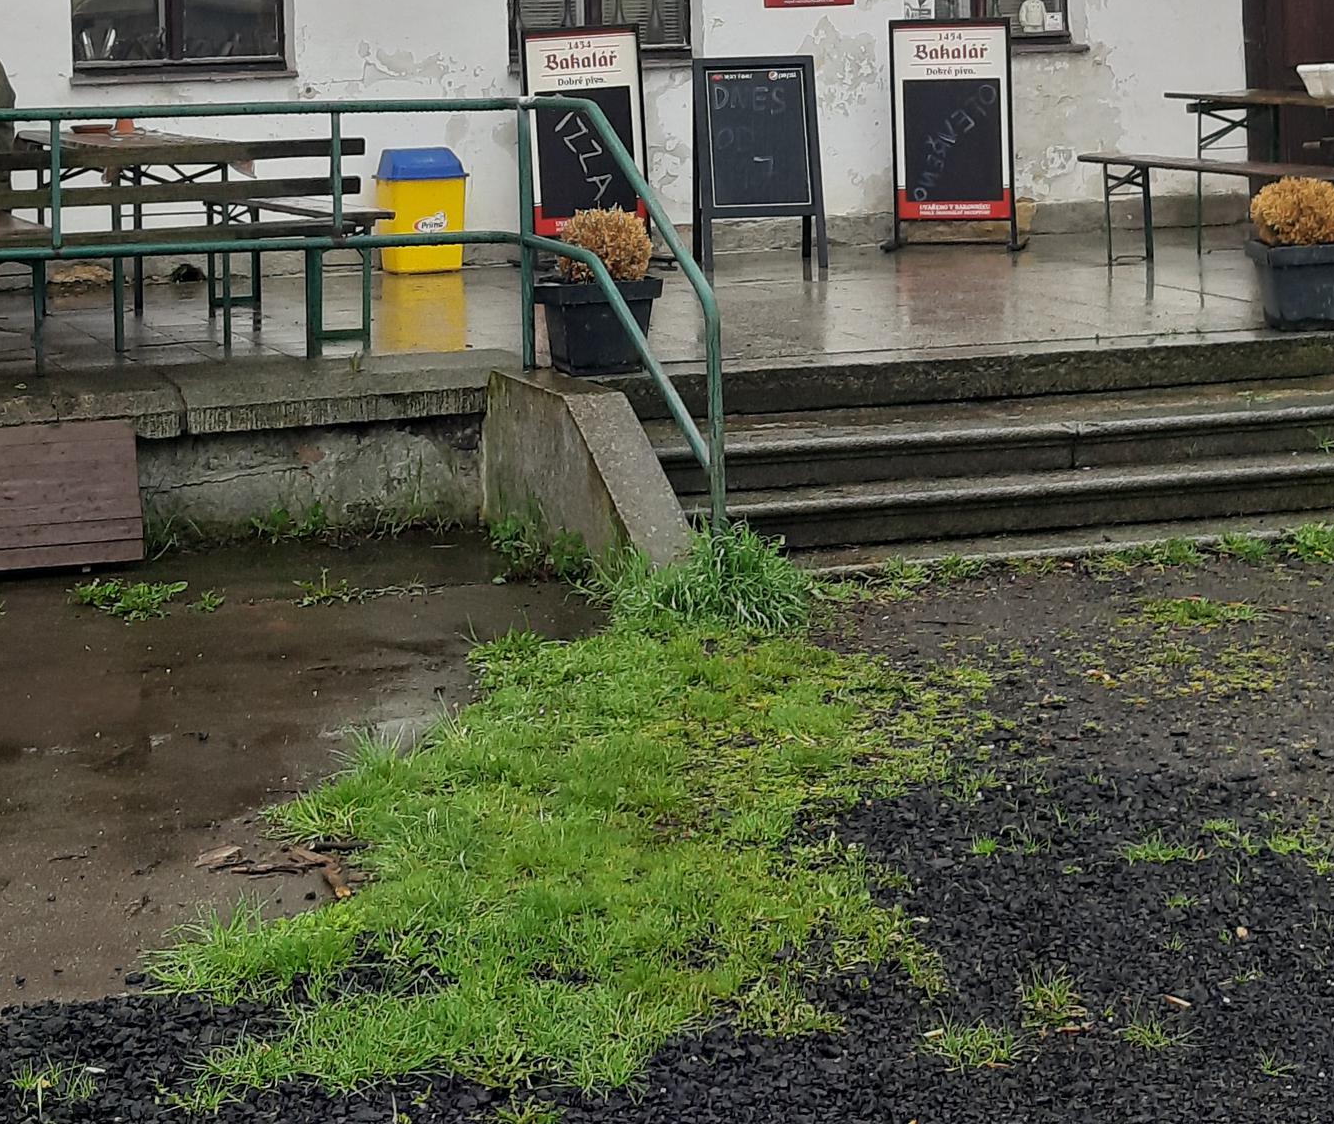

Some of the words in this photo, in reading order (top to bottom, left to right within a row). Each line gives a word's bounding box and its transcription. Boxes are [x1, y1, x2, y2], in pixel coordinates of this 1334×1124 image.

[938, 32, 962, 41] 1454
[567, 41, 591, 50] 1454
[914, 43, 988, 61] Bakalář
[544, 51, 617, 71] Bakalář
[926, 66, 952, 76] Dobré
[557, 76, 584, 87] Dobré
[554, 111, 613, 202] IZZA
